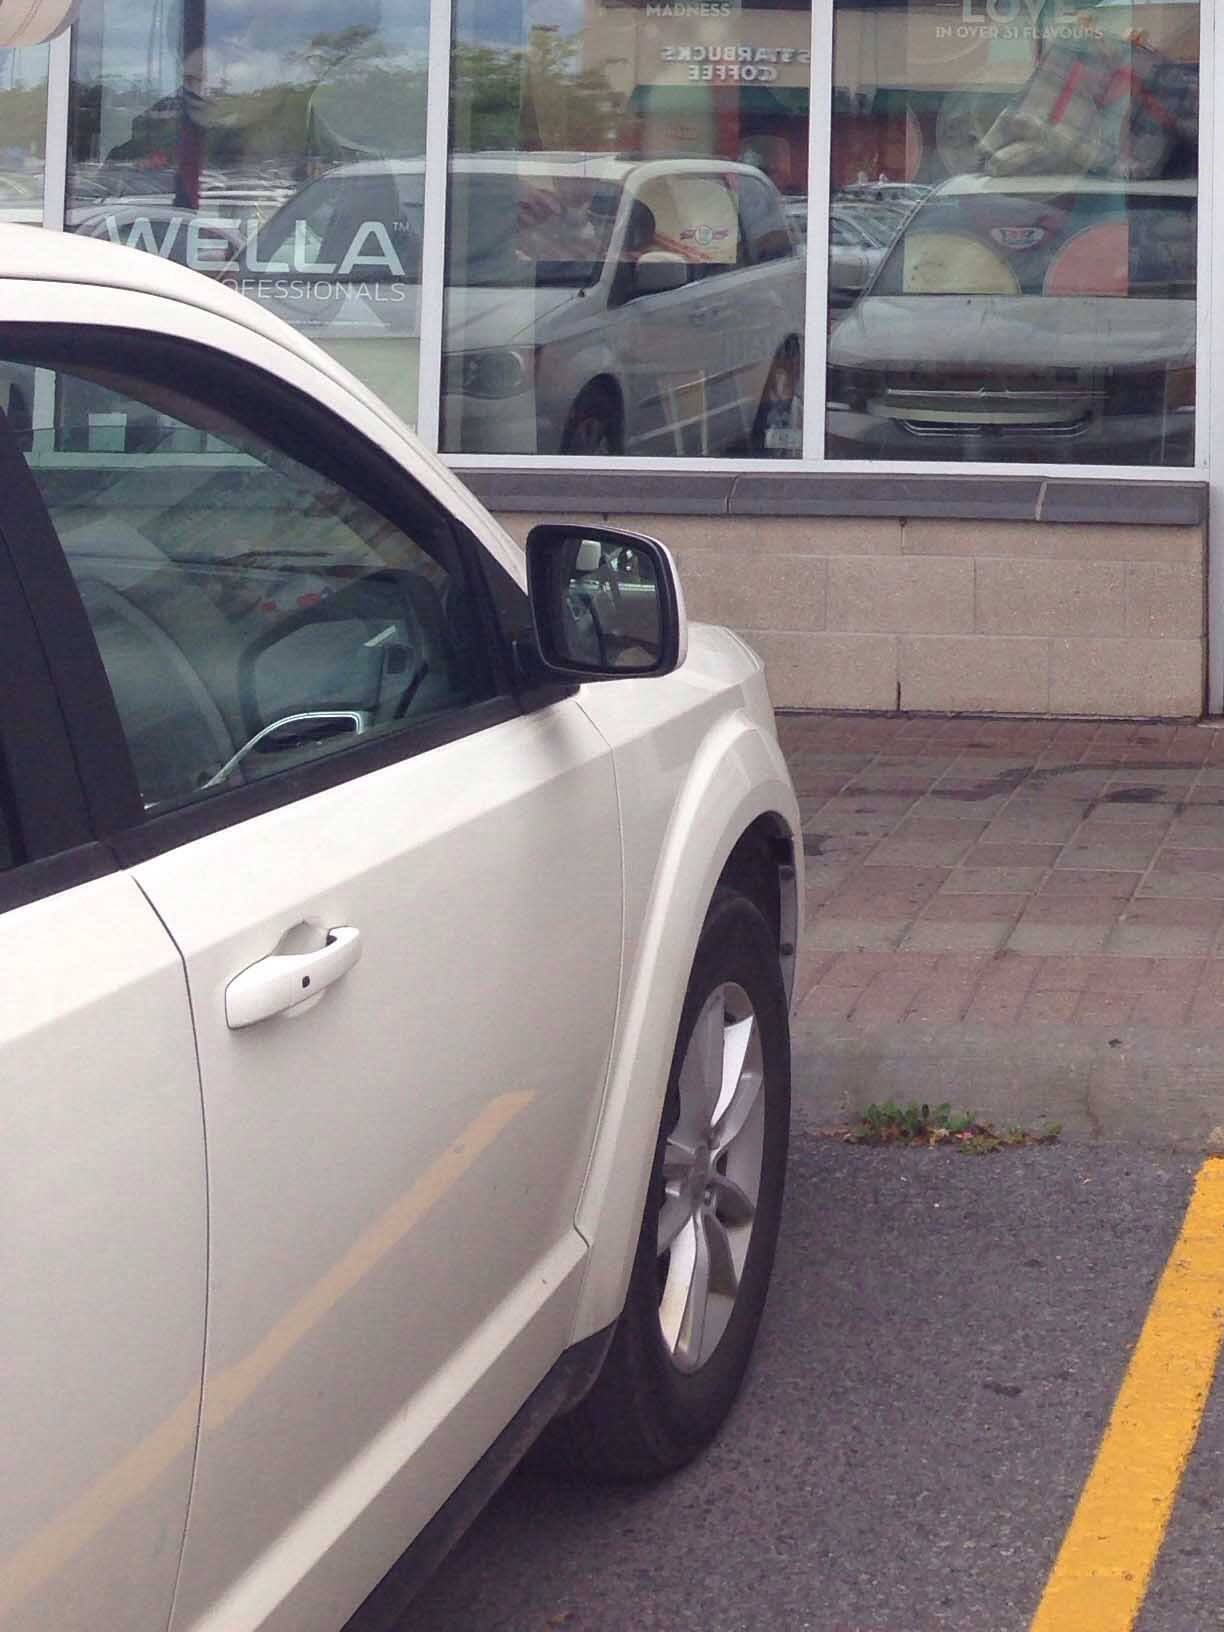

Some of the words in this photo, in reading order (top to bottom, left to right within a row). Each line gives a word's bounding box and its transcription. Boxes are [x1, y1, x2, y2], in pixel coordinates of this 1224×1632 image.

[646, 3, 731, 16] MADNESS
[936, 26, 951, 38] IN
[956, 26, 998, 40] OVER
[105, 216, 406, 275] WELLA
[222, 278, 406, 302] OFESSIONALS
